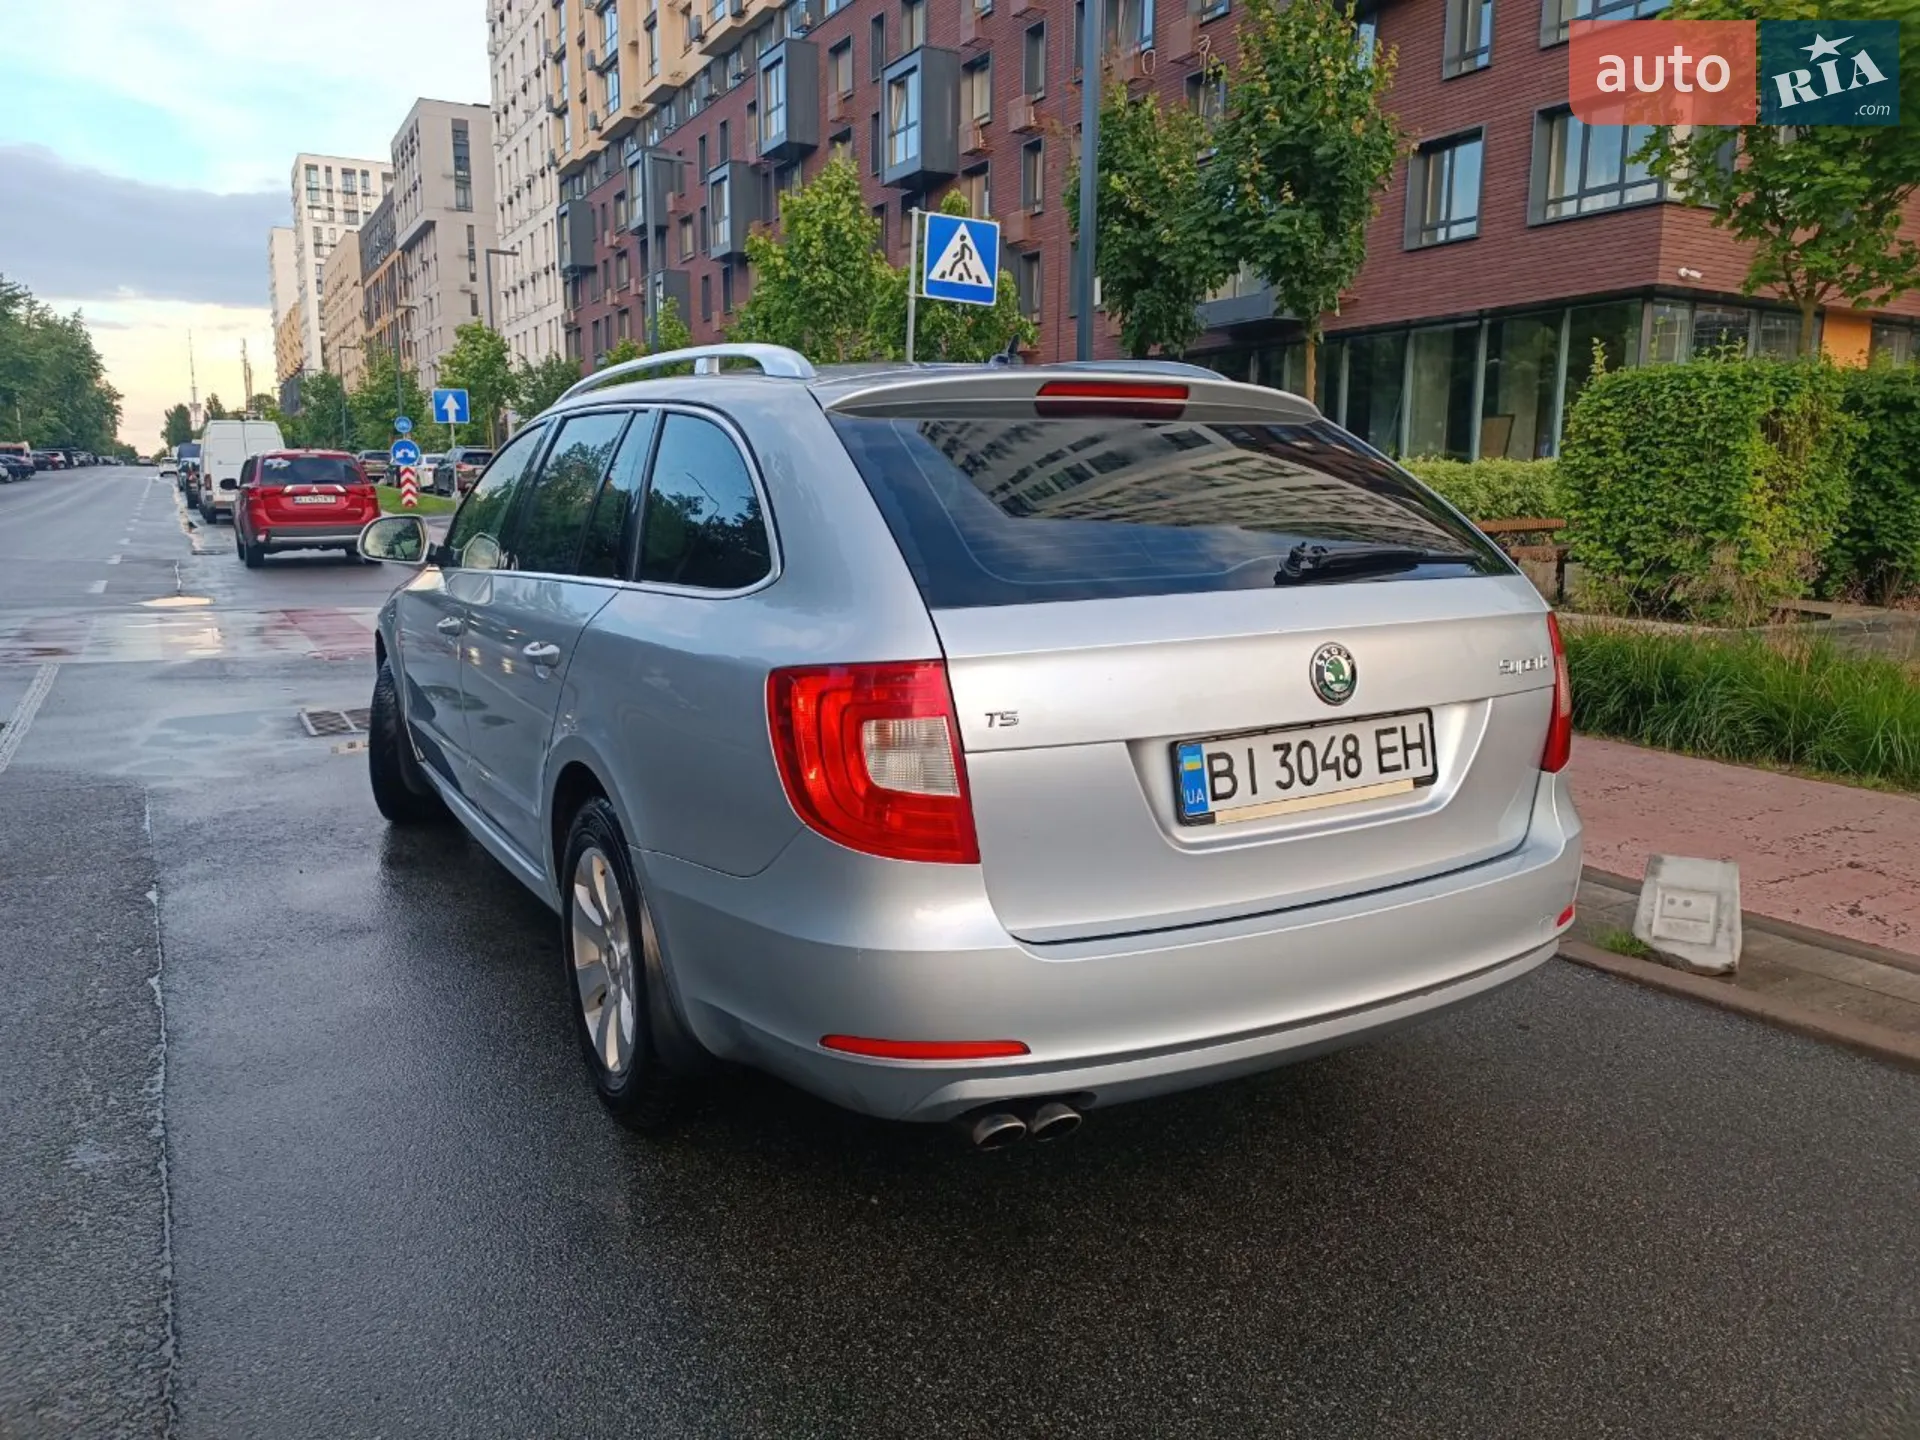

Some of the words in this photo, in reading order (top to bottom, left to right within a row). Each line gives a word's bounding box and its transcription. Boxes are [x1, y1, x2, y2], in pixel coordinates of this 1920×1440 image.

[1206, 747, 1258, 802] BI
[1272, 733, 1363, 791] 3048
[1375, 722, 1428, 775] EH
[1186, 788, 1205, 805] UA
